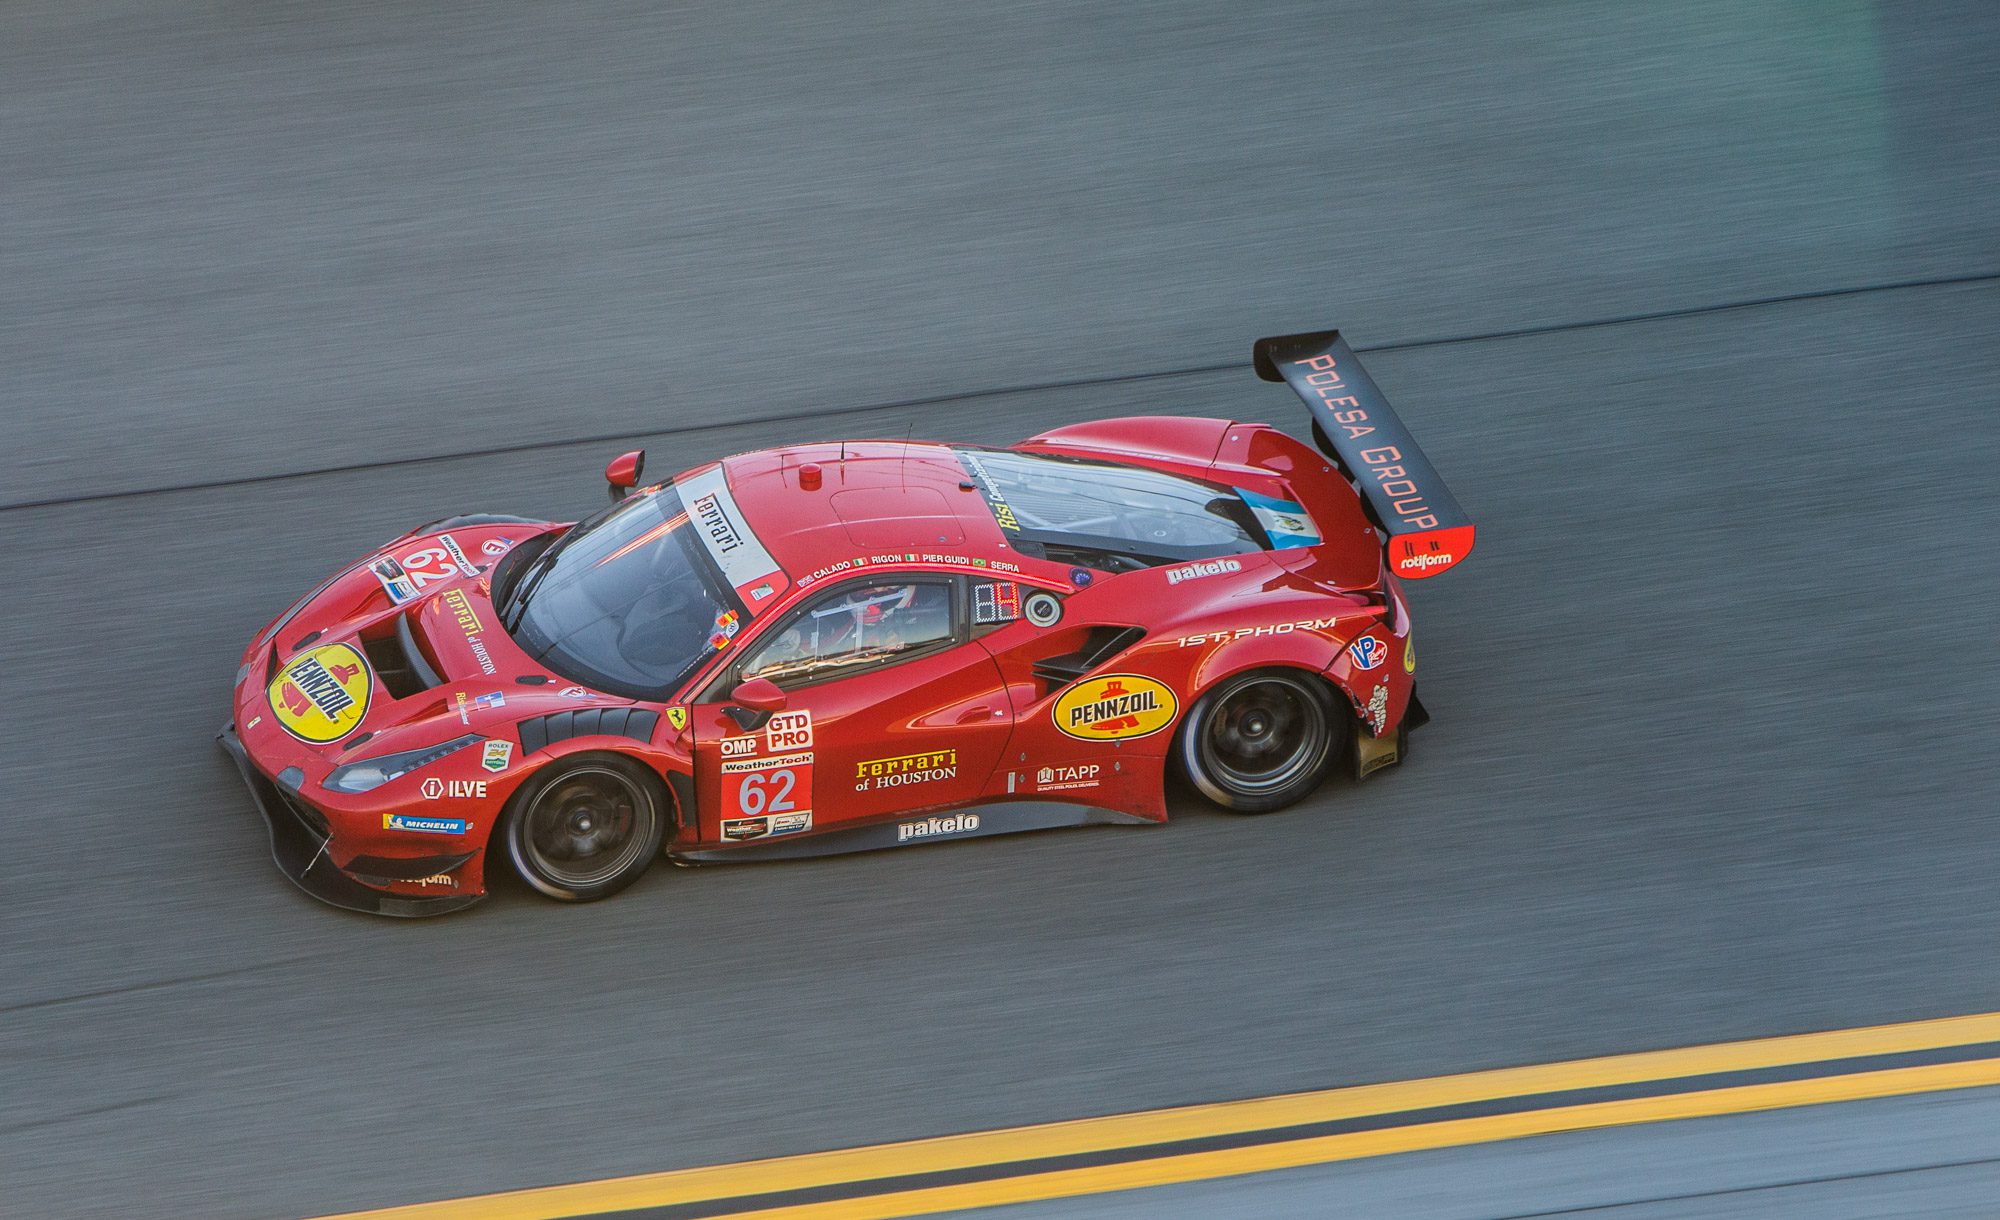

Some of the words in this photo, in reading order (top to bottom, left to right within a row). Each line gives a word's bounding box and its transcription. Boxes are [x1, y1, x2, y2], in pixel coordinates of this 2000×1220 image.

[1294, 354, 1376, 440] POLESA
[1360, 446, 1439, 530] GROUP
[694, 492, 744, 554] Ferrari
[995, 503, 1020, 532] Risi
[402, 548, 459, 588] 62
[813, 561, 851, 580] CALADO
[871, 554, 902, 564] RIGON
[922, 554, 943, 563] PIER
[944, 555, 970, 565] GUIDI
[990, 561, 1020, 573] SERRA
[1401, 554, 1452, 571] rotiform
[1167, 559, 1242, 585] pakelo
[443, 588, 484, 637] Ferrari
[1178, 632, 1229, 648] 1ST
[1234, 617, 1337, 640] PHORM
[472, 642, 496, 676] HOUSTON
[1350, 635, 1376, 669] VP
[768, 714, 808, 732] GTD
[1070, 693, 1159, 728] PENNZOIL
[720, 738, 757, 756] OMP
[771, 730, 809, 749] PRO
[725, 754, 813, 772] WeatherTech
[856, 749, 957, 779] Ferrari
[1055, 765, 1100, 781] TAPP
[448, 780, 487, 798] ILVE
[855, 777, 870, 792] of
[876, 767, 957, 789] HOUSTON
[739, 769, 796, 816] 62
[405, 820, 459, 830] MICHELIN
[898, 814, 980, 841] pakelo
